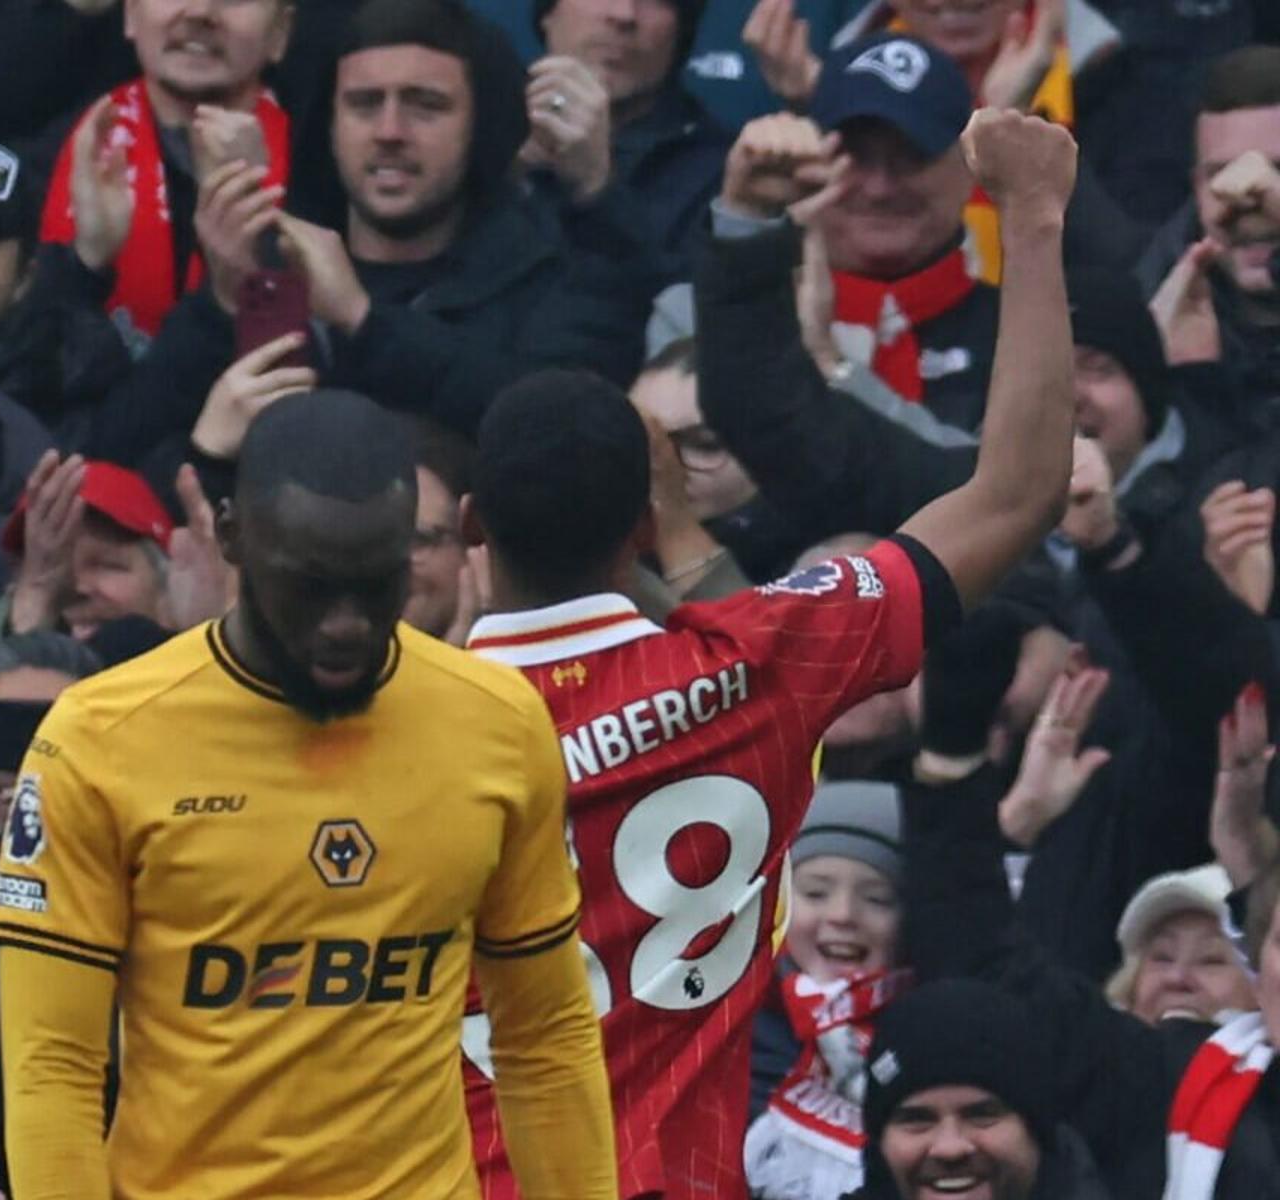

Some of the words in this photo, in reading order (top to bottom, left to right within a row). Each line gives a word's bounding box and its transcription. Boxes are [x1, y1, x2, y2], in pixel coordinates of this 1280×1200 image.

[561, 662, 747, 783] NBERCH
[172, 795, 247, 816] SUDU
[182, 928, 456, 1009] DEBET
